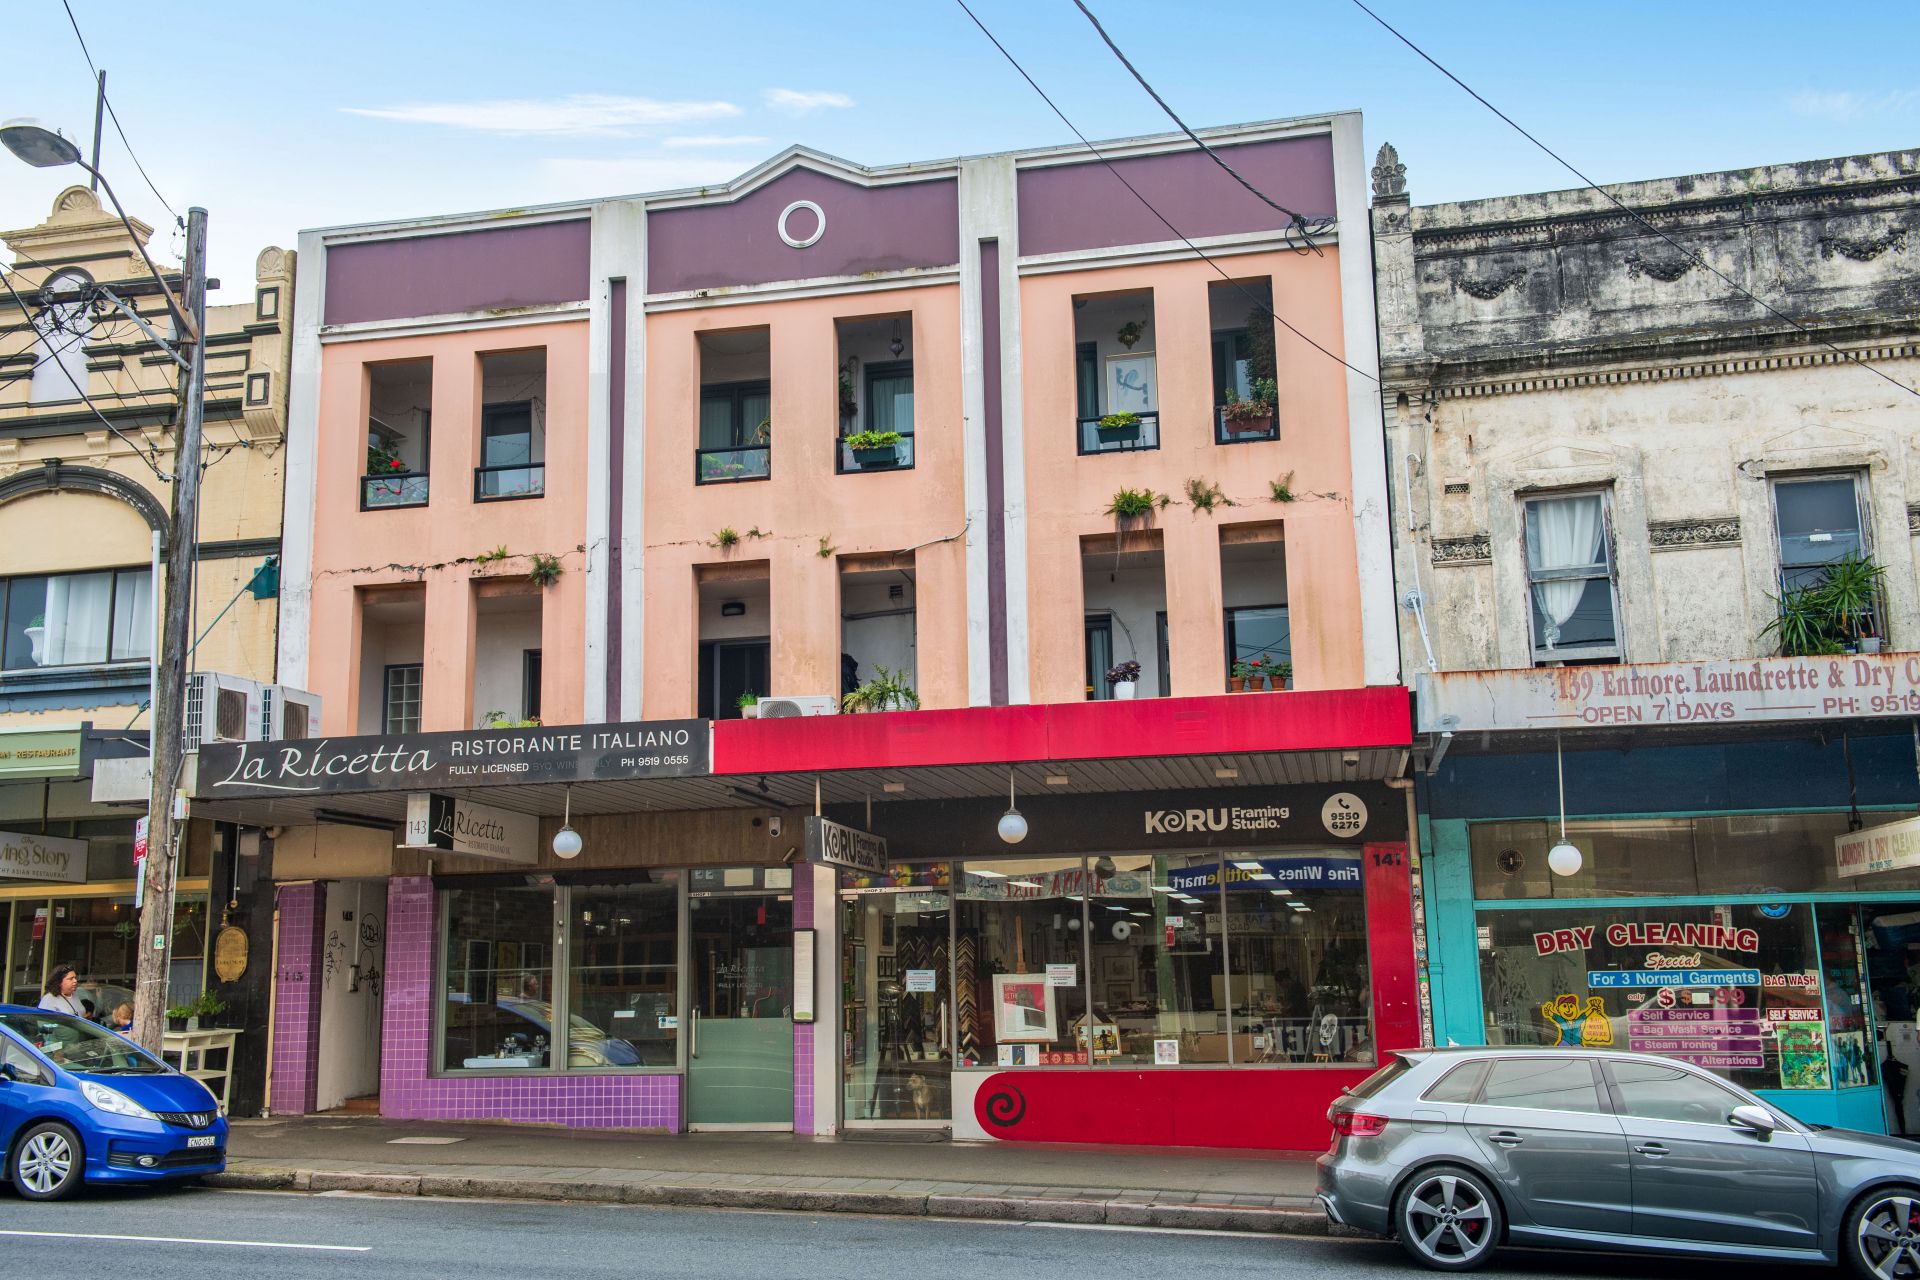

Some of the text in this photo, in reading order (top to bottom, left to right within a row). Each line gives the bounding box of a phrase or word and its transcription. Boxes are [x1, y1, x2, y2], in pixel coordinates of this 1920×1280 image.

[1557, 670, 1594, 701] 139
[1601, 670, 1686, 697] Enmore
[1693, 661, 1819, 693] Laundrette
[1828, 660, 1845, 689] &
[1853, 659, 1895, 695] Dry
[1823, 694, 1920, 714] PH: 9519
[1583, 701, 1735, 723] OPEN 7 DAYS
[451, 729, 689, 757] RISTORANTE ITALIANO
[16, 748, 77, 759] RESTAURANT
[279, 740, 438, 779] Ricetta
[621, 755, 689, 767] PH 9519 0555
[449, 762, 529, 775] FULLY LICENSED
[1145, 805, 1289, 834] KORU Framing
[1331, 811, 1360, 821] 9550
[409, 820, 427, 834] 143
[456, 809, 505, 841] Ricetta
[1232, 818, 1280, 830] Studio.
[1331, 820, 1360, 830] 6276
[823, 823, 857, 863] KORU
[32, 844, 70, 872] Story
[1533, 923, 1759, 956] DRY CLEANING
[1644, 952, 1701, 970] Special
[1592, 972, 1755, 985] For 3 Normal Garments
[1764, 975, 1817, 987] BAG WASH
[1627, 992, 1646, 1002] only
[1642, 1010, 1710, 1020] Self Service
[1769, 1009, 1819, 1020] SELF SERVICE
[1643, 1024, 1742, 1035] Bag Wash Service
[1644, 1040, 1718, 1051] Steam Ironing
[1701, 1055, 1758, 1065] Alterations
